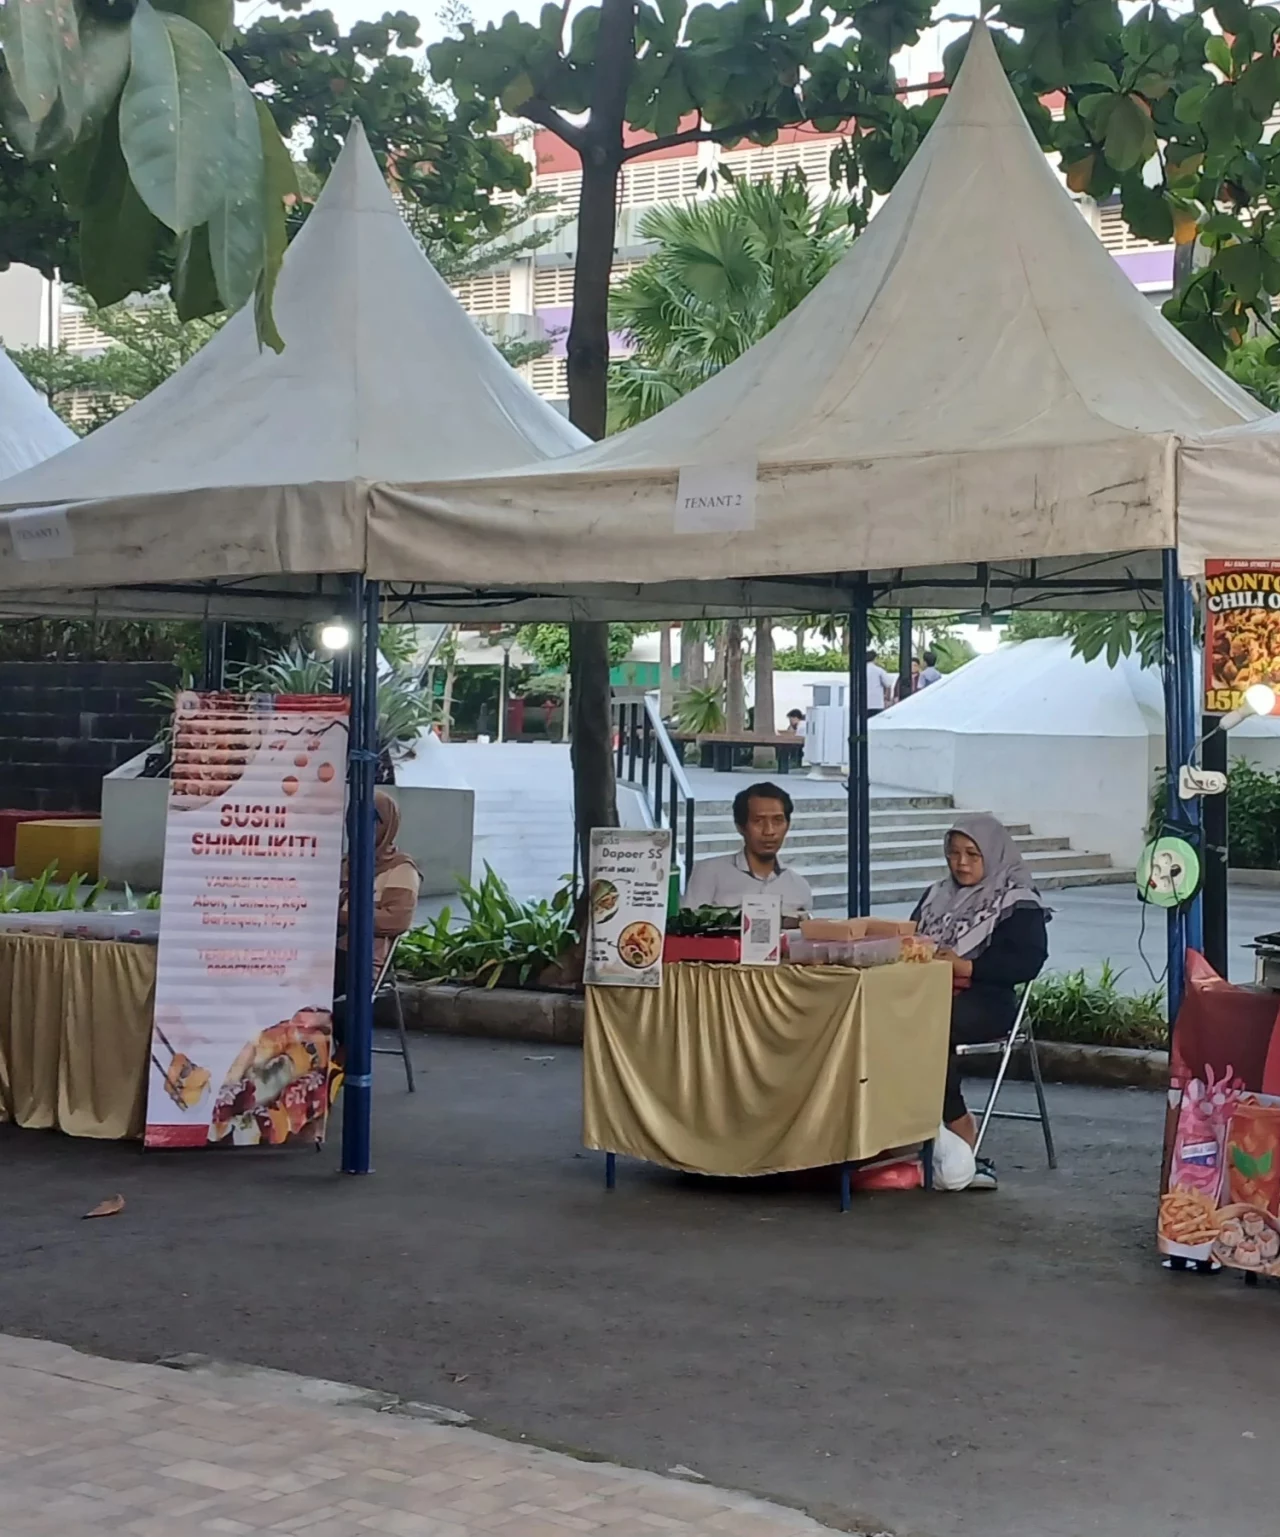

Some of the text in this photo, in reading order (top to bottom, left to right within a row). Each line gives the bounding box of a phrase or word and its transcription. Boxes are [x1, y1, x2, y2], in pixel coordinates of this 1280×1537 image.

[684, 494, 742, 509] TENANT 2
[1208, 591, 1265, 612] CHILI
[220, 804, 287, 828] SUSHI
[602, 848, 663, 861] Dapoer SS
